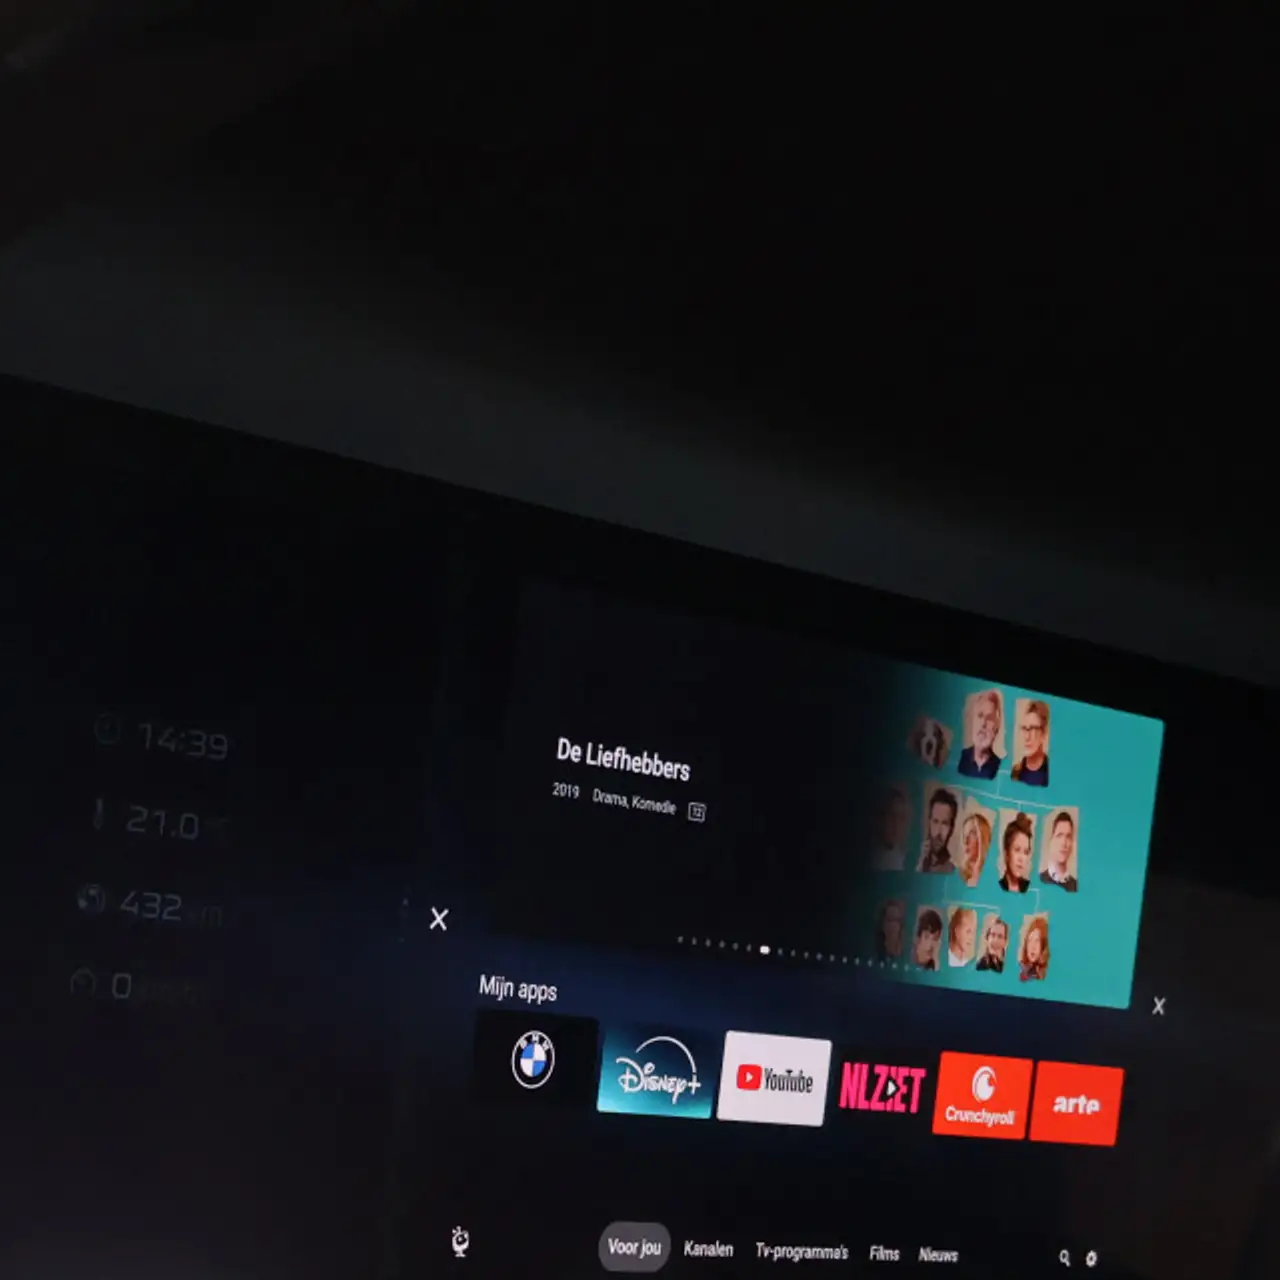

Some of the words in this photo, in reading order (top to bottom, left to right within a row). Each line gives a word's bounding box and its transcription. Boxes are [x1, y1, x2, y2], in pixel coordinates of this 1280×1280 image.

[137, 722, 228, 761] 14:39
[556, 737, 582, 762] De
[585, 742, 691, 781] Liefhebbers
[552, 782, 580, 799] 2019
[593, 788, 629, 809] Drama,
[631, 795, 677, 815] Komedie
[126, 804, 199, 840] 21.0
[120, 889, 182, 921] 432
[112, 972, 132, 999] 0
[479, 974, 514, 1001] Mijn
[518, 981, 558, 1005] apps
[763, 1067, 814, 1094] YouTube
[945, 1104, 1016, 1128] Crunchyroll
[1053, 1094, 1102, 1115] arte
[608, 1238, 639, 1256] Voor
[640, 1238, 663, 1259] jou
[683, 1240, 734, 1258] Kanalen
[756, 1242, 849, 1262] Tv-programma's
[869, 1246, 901, 1262] Films
[918, 1247, 959, 1263] Nieuws
